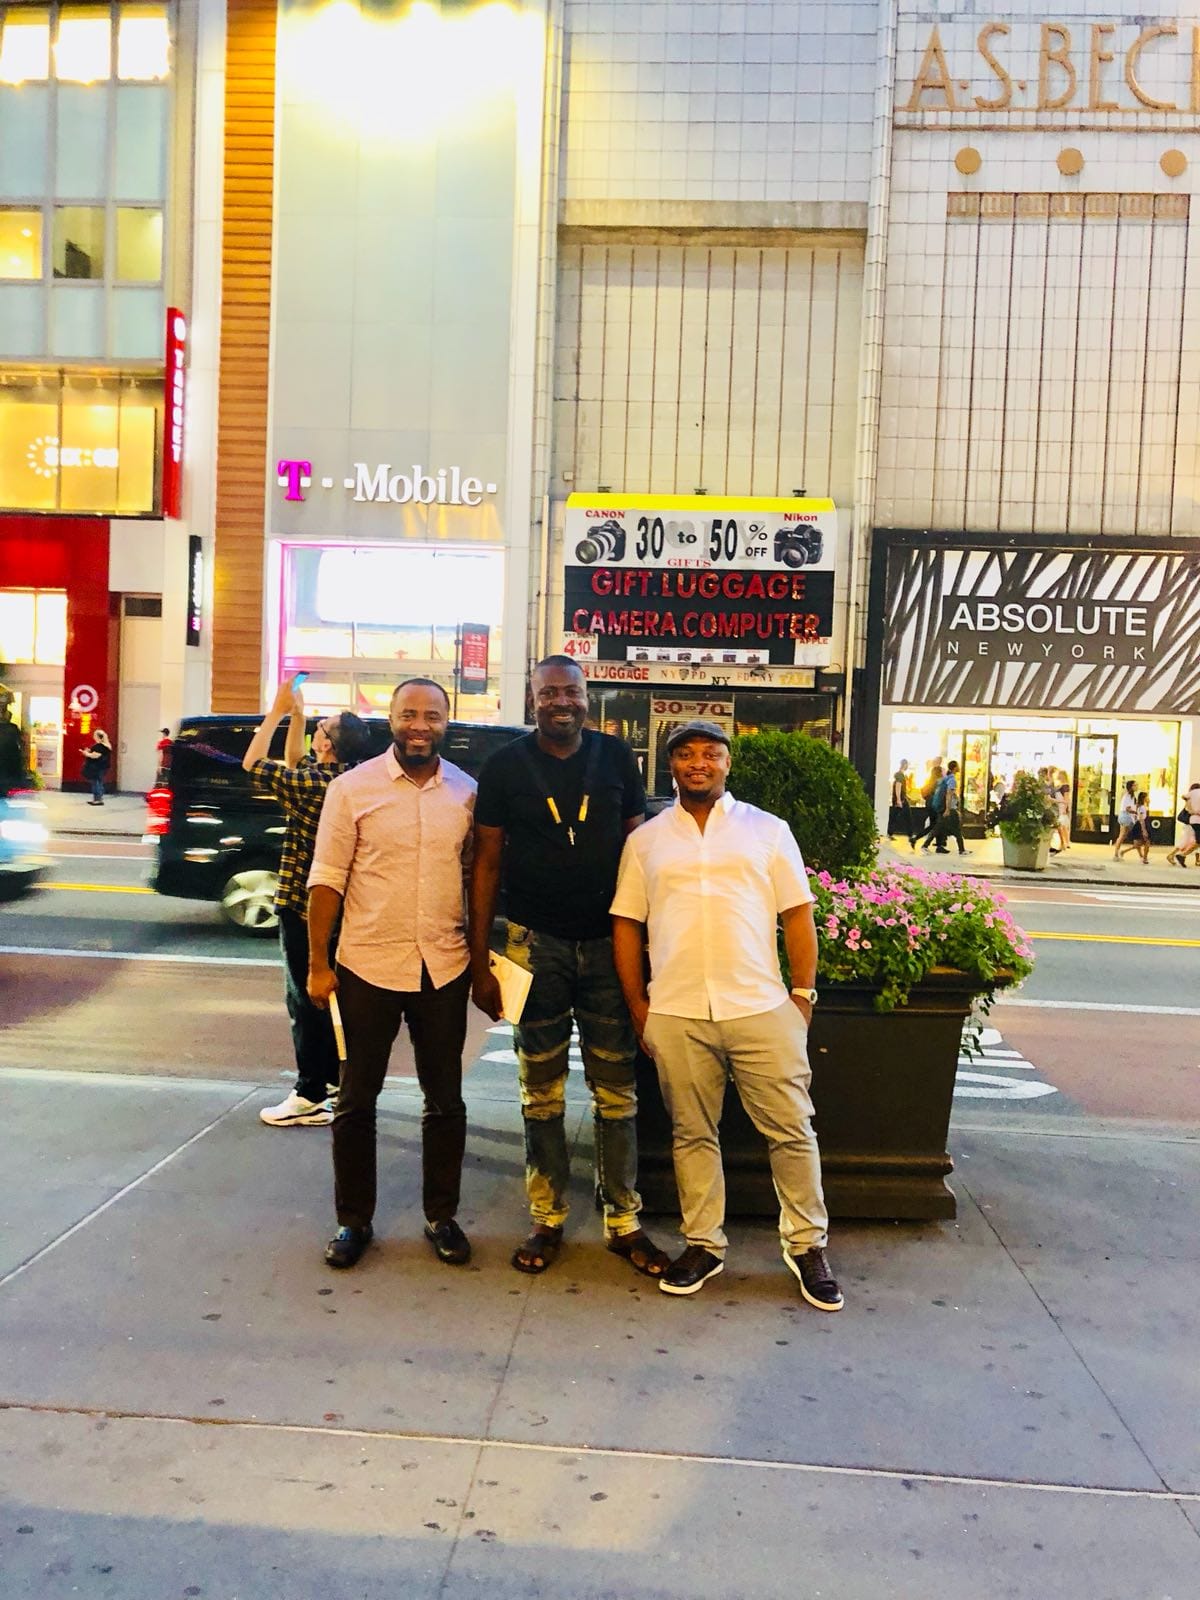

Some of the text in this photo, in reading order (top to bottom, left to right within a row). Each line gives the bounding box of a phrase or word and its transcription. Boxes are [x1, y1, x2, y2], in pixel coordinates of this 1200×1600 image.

[585, 510, 625, 518] CANON
[784, 513, 817, 522] Nikon
[636, 516, 664, 560] 30
[677, 531, 697, 543] to
[709, 519, 738, 561] 50
[745, 547, 768, 557] OFF
[667, 559, 711, 567] GIFTS
[949, 602, 1148, 637] ABSOLUTE
[947, 641, 1146, 660] NEW YORK
[594, 665, 649, 680] LUGGAGE
[711, 676, 731, 687] NY
[654, 701, 682, 714] 30
